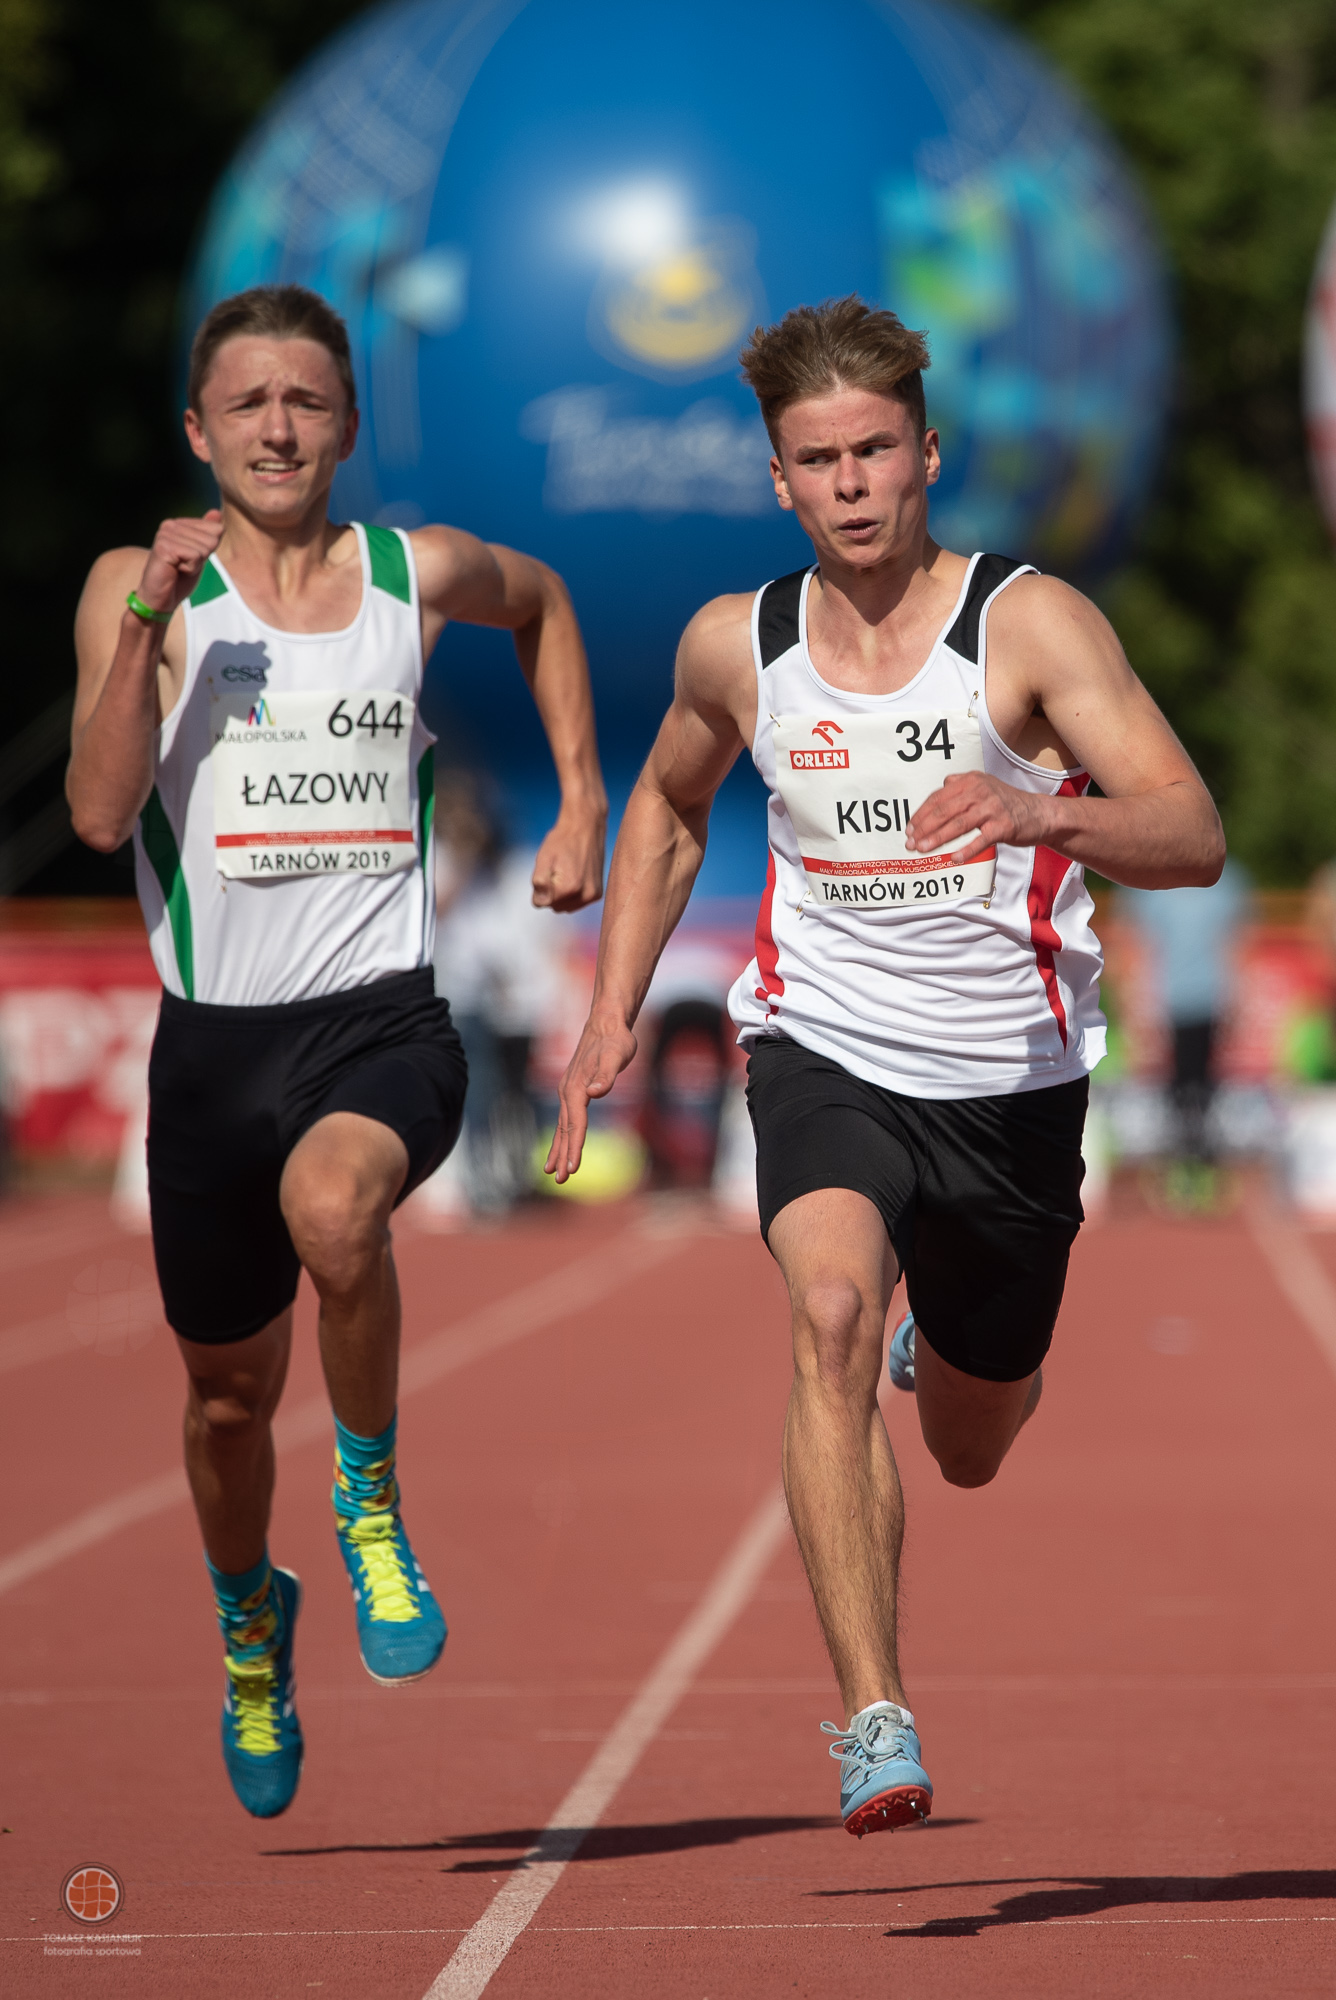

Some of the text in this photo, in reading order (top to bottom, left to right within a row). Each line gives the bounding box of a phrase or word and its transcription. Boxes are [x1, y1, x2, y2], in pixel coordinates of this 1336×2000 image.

[221, 664, 267, 682] esa
[328, 699, 405, 739] 644
[215, 730, 307, 744] MAŁOPOLSKA
[895, 719, 955, 762] 34
[793, 751, 847, 768] ORLEN
[241, 773, 389, 806] ŁAZOWY
[250, 848, 392, 872] TARNÓW 2019
[849, 860, 901, 869] MISTRZOSTWA
[902, 857, 928, 867] POLSKI
[870, 867, 904, 875] JANUSZA
[822, 874, 966, 902] TARNÓW 2019
